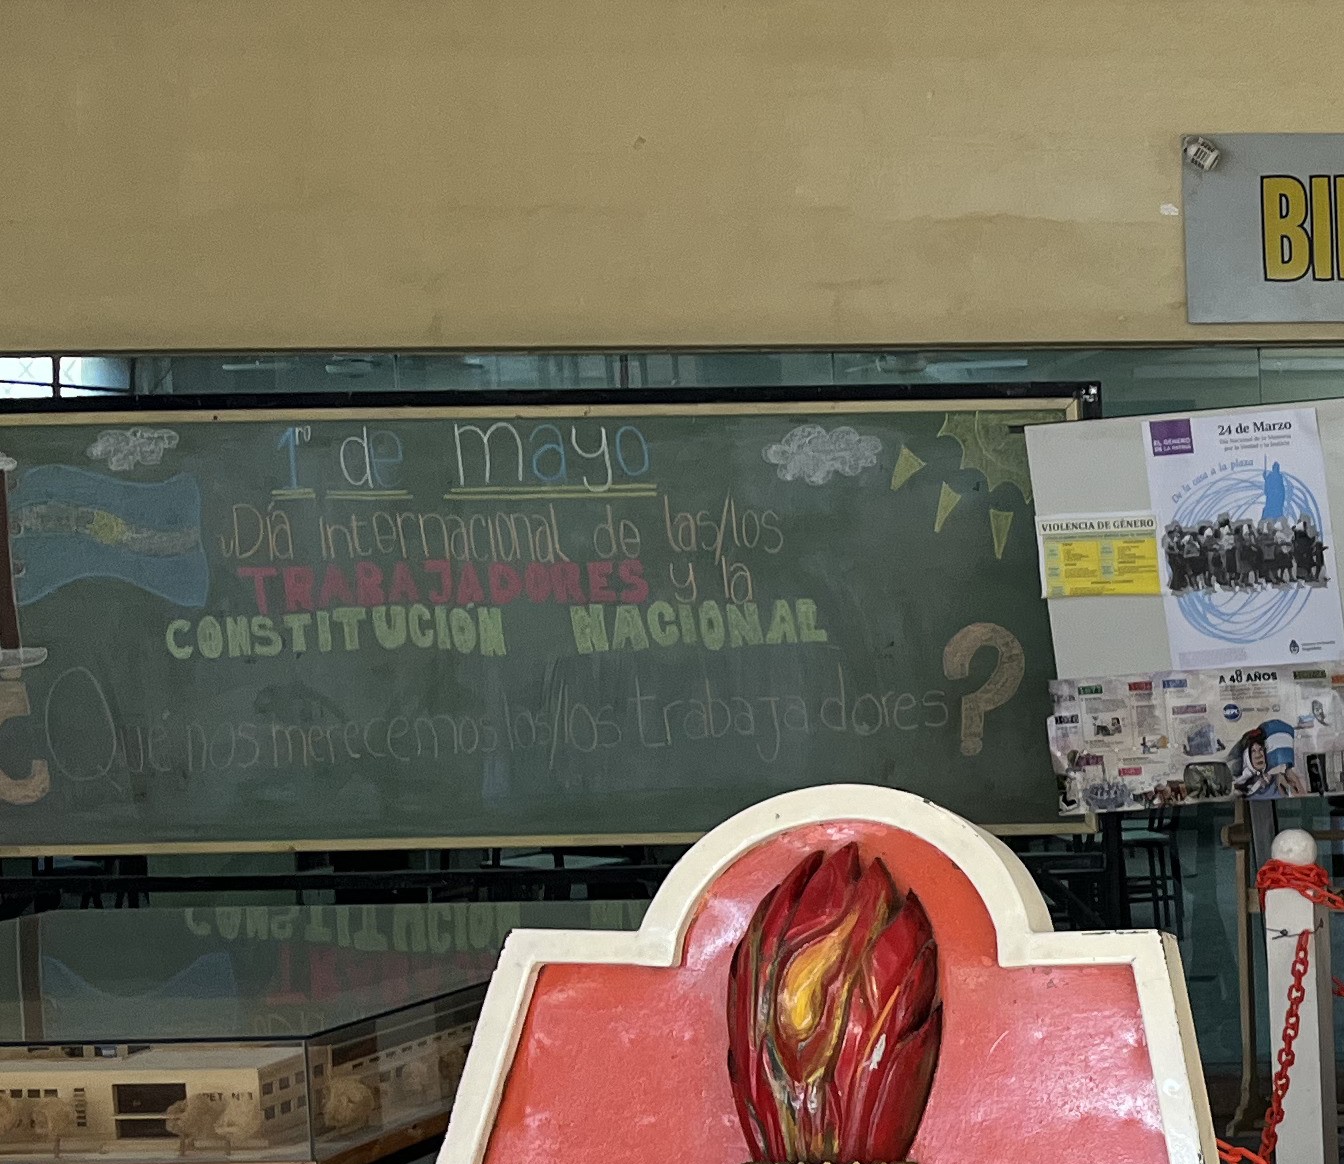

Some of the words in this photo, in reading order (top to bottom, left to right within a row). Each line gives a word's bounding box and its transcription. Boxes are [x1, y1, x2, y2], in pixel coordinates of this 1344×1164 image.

[1217, 424, 1232, 436] 24
[1235, 422, 1249, 434] de
[1253, 420, 1292, 433] Marzo
[339, 424, 403, 488] de
[453, 422, 650, 493] mayo
[1231, 458, 1254, 472] plaza
[593, 503, 641, 558] de
[1041, 521, 1095, 532] VIOLENCIA
[1097, 520, 1109, 530] DE
[237, 559, 650, 614] TRABAJADORES
[668, 563, 697, 603] y
[721, 555, 755, 604] la
[165, 602, 507, 659] CONSTITUCIÓN
[569, 598, 829, 655] NACIONAL
